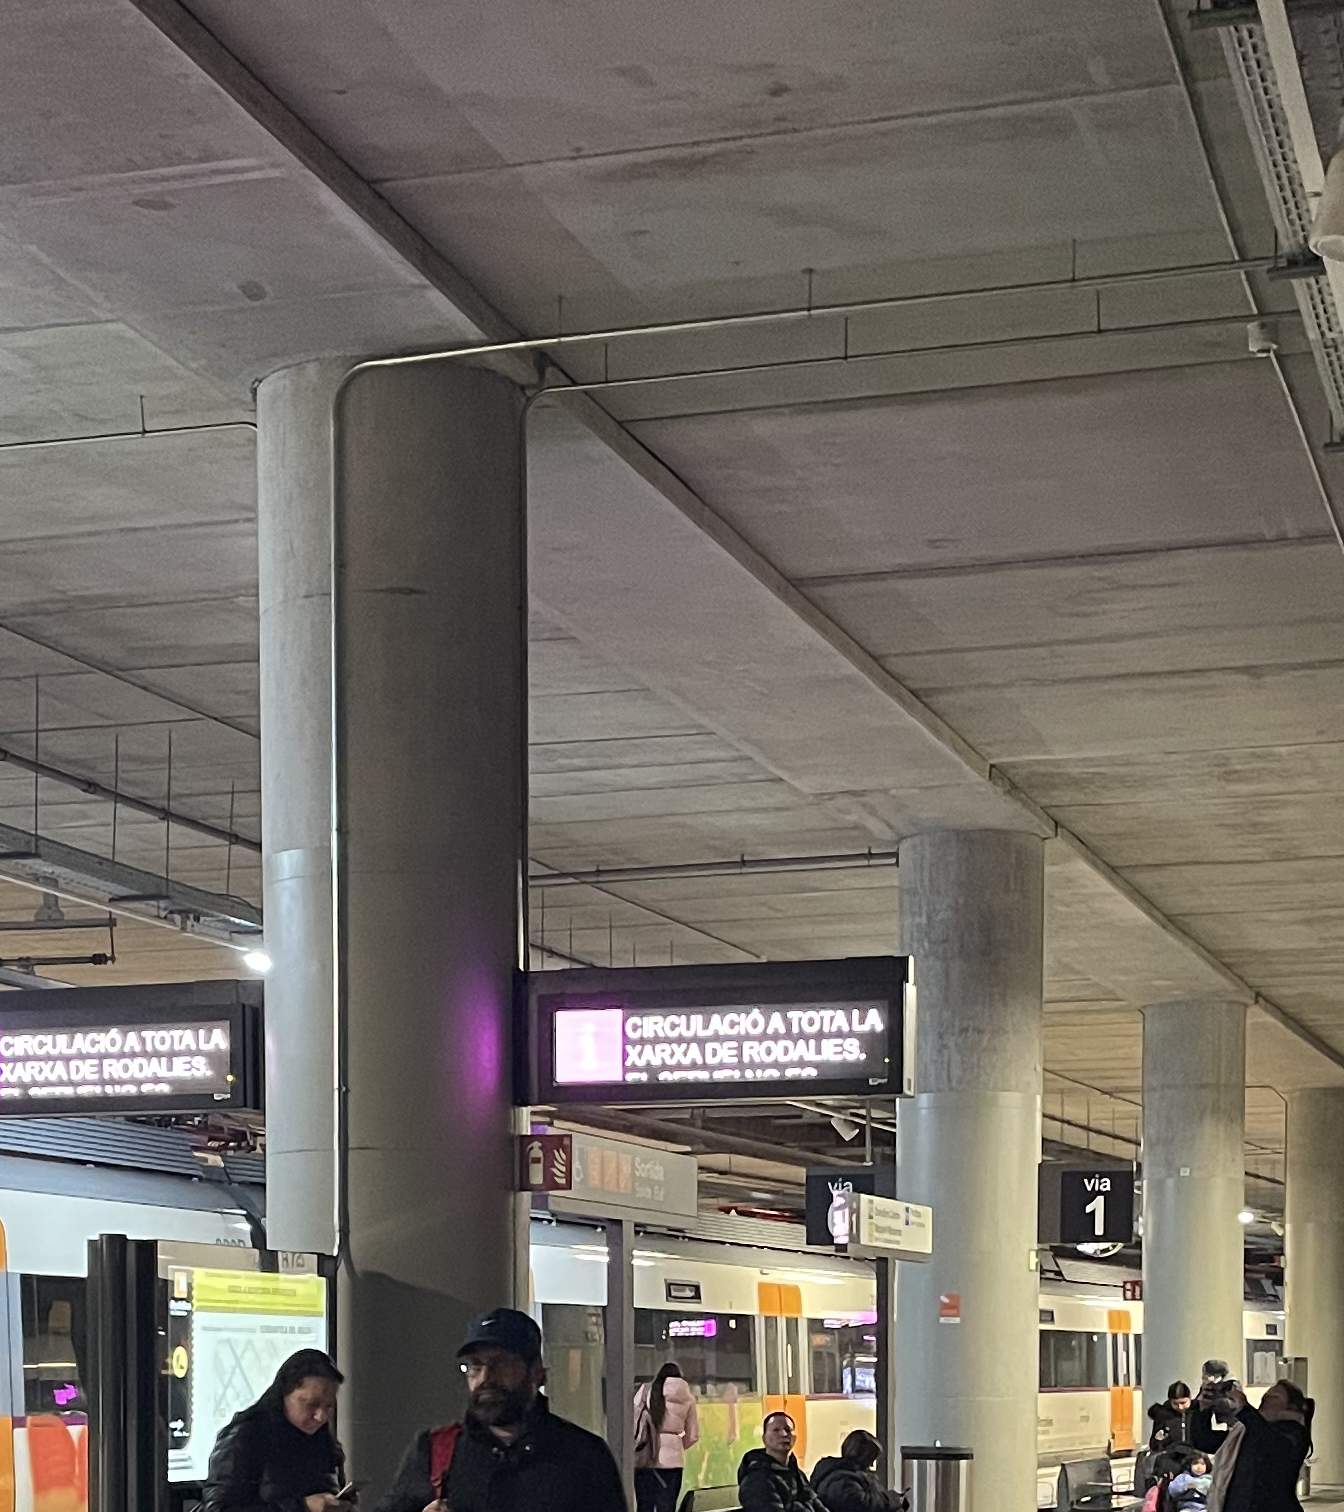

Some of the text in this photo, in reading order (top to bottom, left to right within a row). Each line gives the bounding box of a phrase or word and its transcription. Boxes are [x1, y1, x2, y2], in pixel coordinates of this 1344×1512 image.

[625, 1008, 883, 1038] CIRCULACIÓ A TOTA LA
[0, 1028, 227, 1057] CIRCULACIÓ A TOTA LA
[624, 1037, 867, 1067] XARXA DE RODALIES.
[0, 1055, 213, 1083] XARXA DE RODALIES.
[1083, 1173, 1111, 1191] via
[1085, 1195, 1104, 1235] 1
